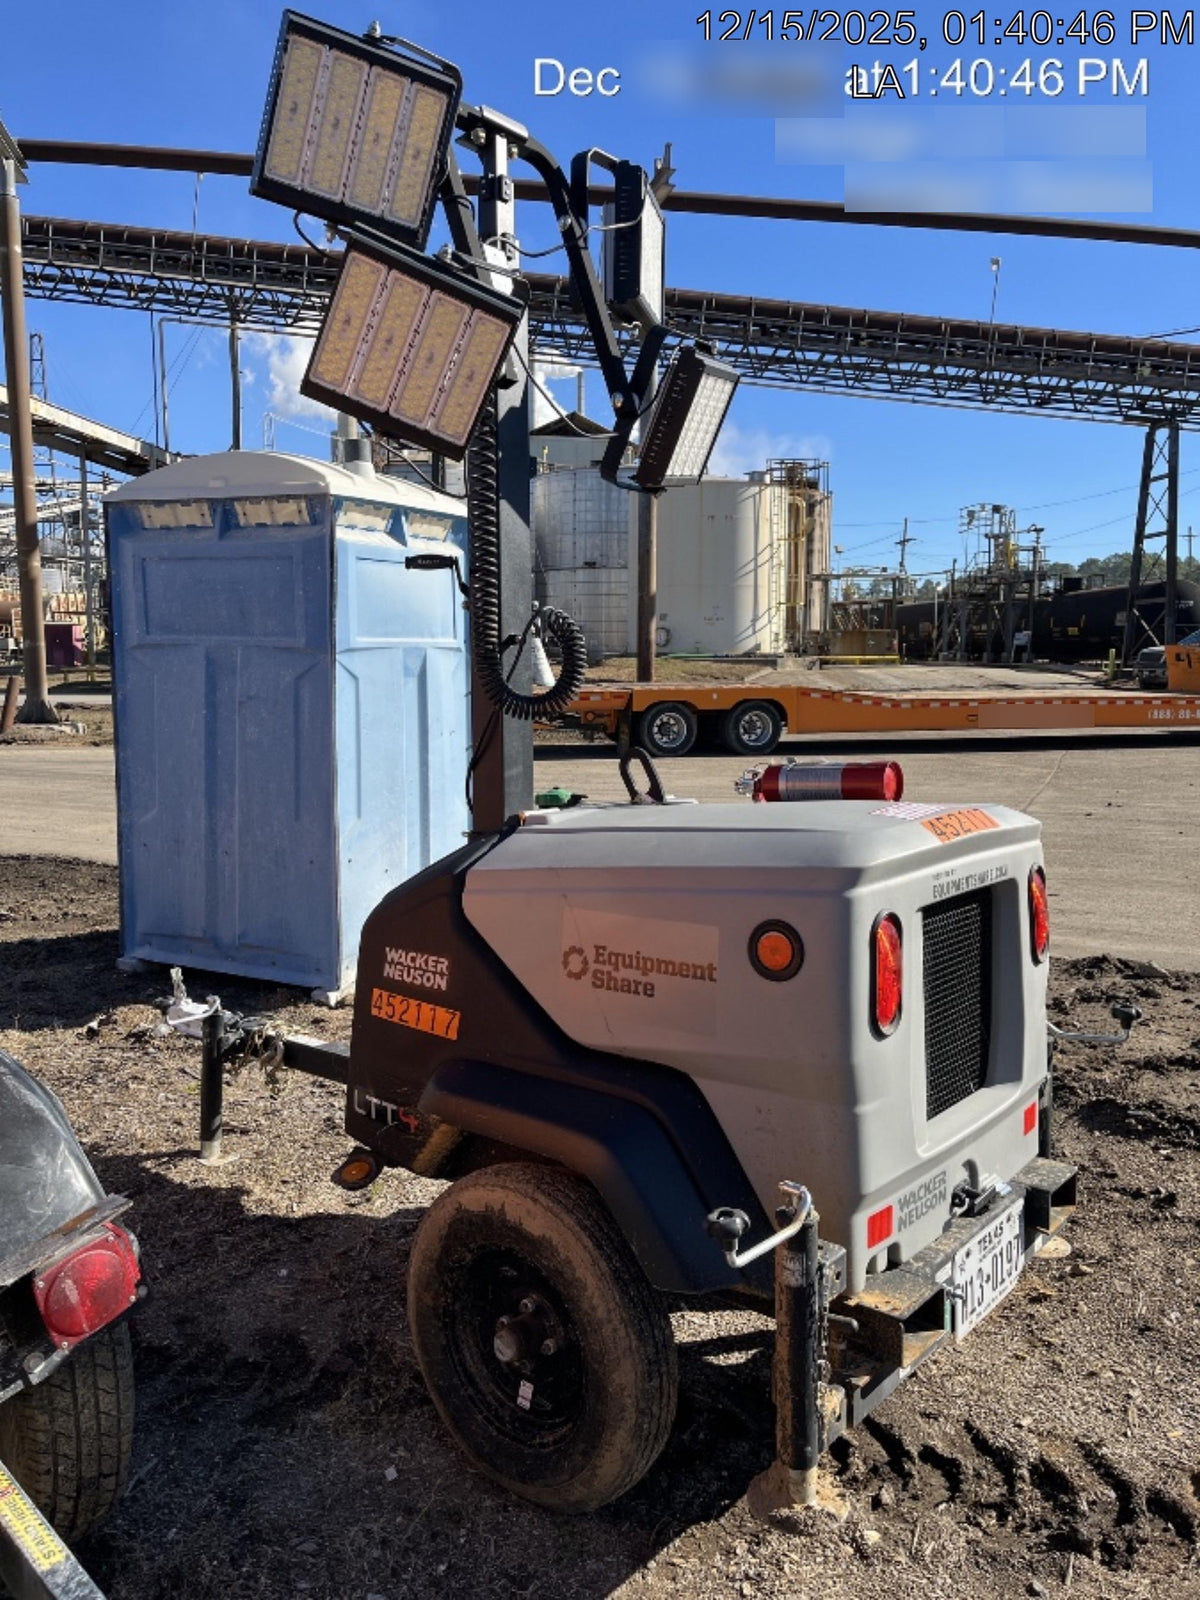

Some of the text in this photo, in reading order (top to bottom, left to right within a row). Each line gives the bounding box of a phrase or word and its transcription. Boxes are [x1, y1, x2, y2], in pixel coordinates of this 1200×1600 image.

[383, 962, 447, 991] NEUSON
[385, 946, 448, 975] WACKER
[593, 944, 717, 983] Equipment
[591, 968, 655, 998] Share
[372, 991, 459, 1037] 452117
[898, 1170, 947, 1213] WACKER
[898, 1186, 947, 1232] NEUSON
